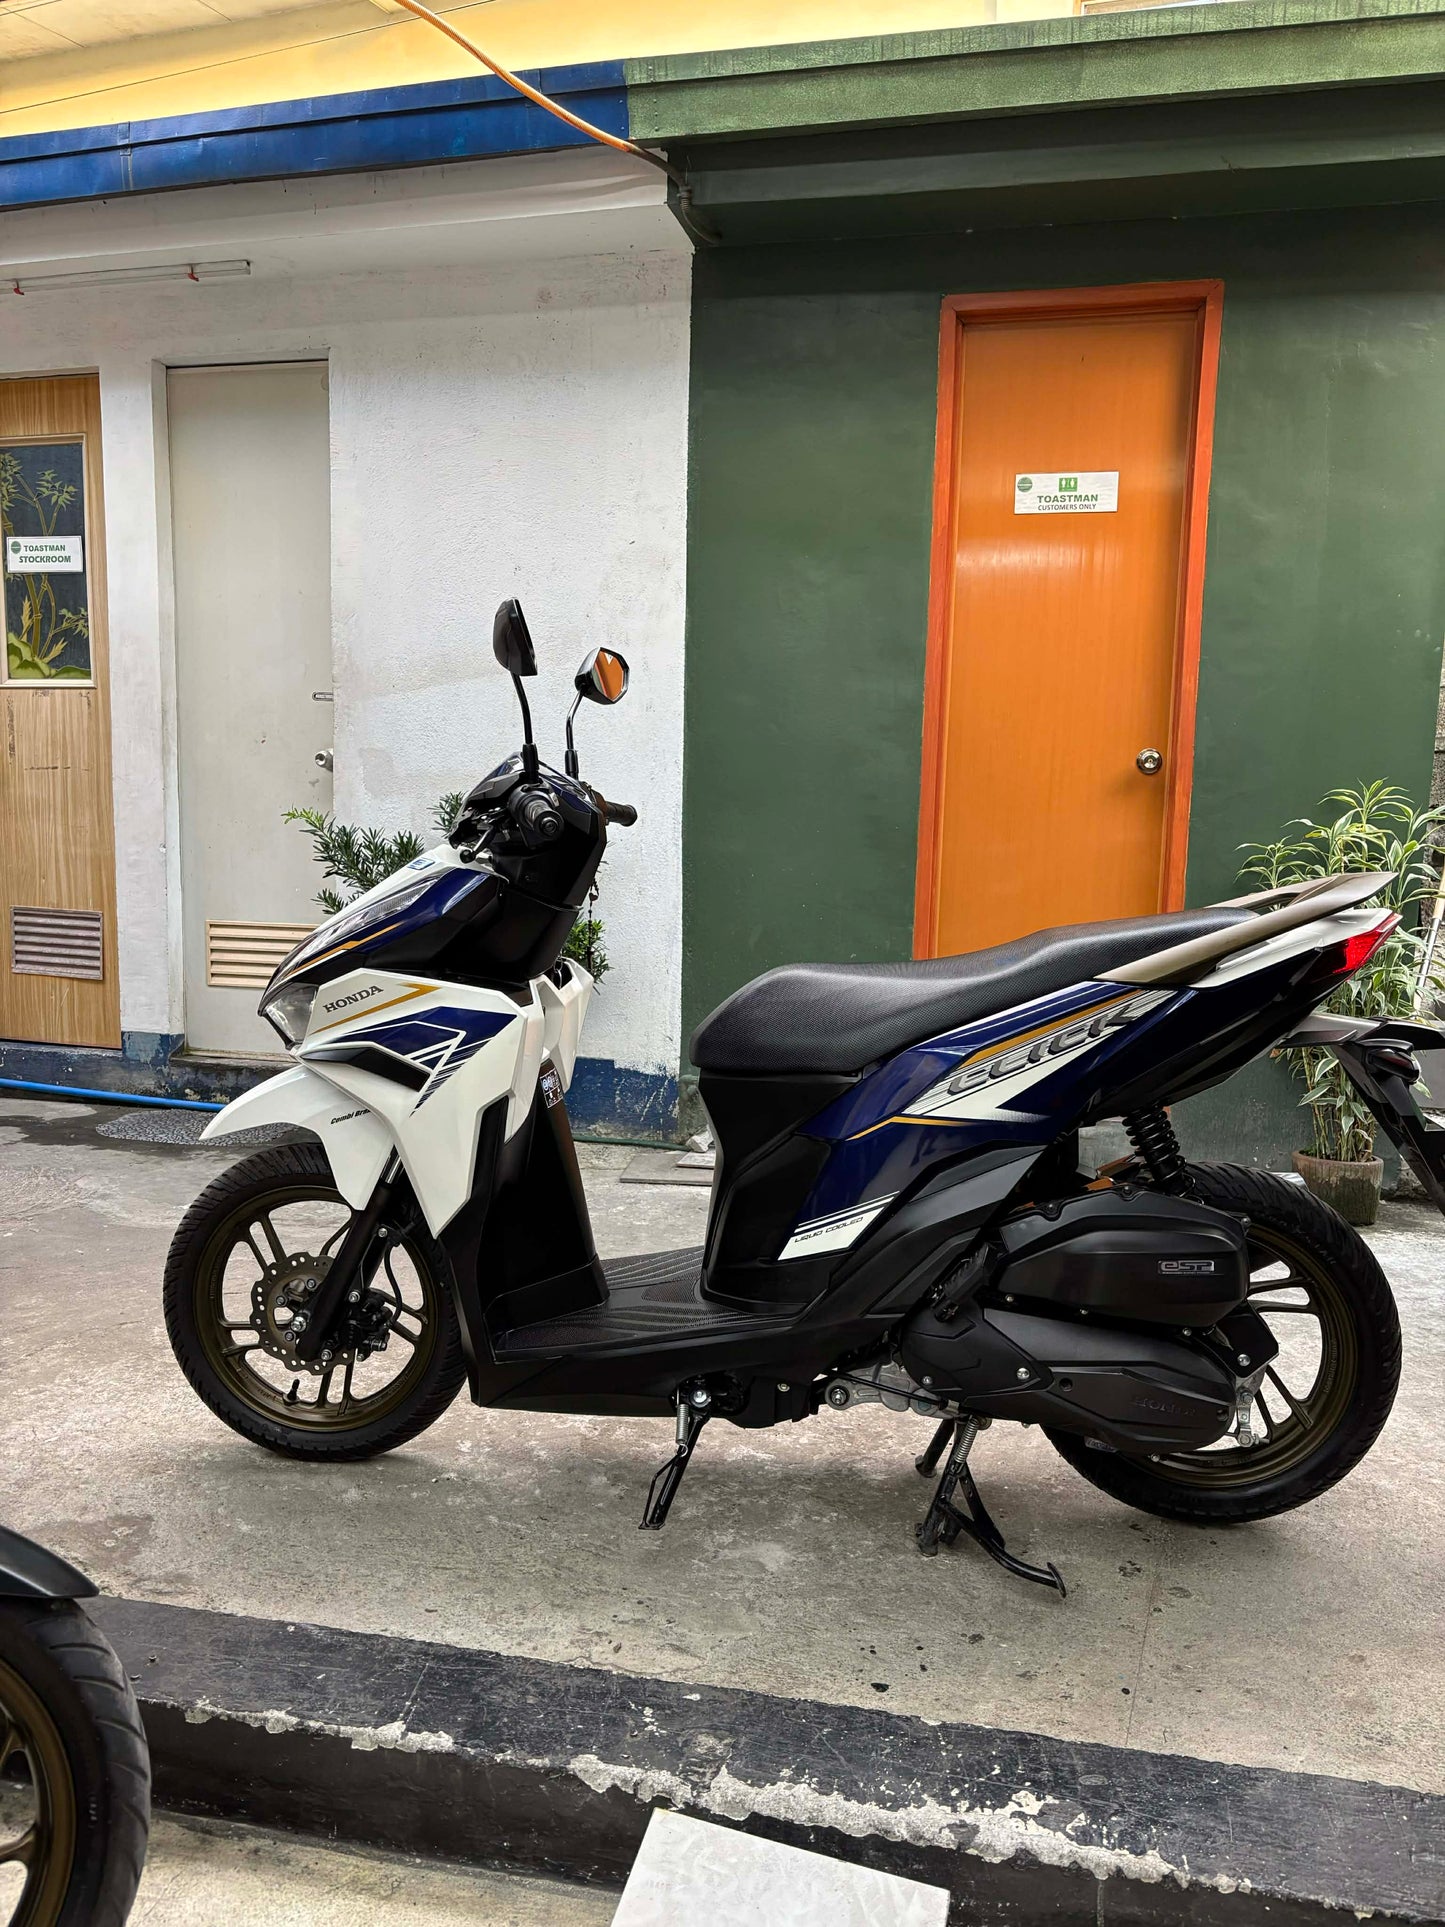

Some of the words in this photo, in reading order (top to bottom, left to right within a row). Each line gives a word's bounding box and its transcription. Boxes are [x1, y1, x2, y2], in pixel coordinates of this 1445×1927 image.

[1037, 494, 1098, 503] TOASTMAN
[1038, 503, 1078, 511] CUSTOMERS
[19, 555, 71, 563] STOCKROOM
[323, 985, 384, 1013] HONDA
[825, 1216, 864, 1233] COOLED
